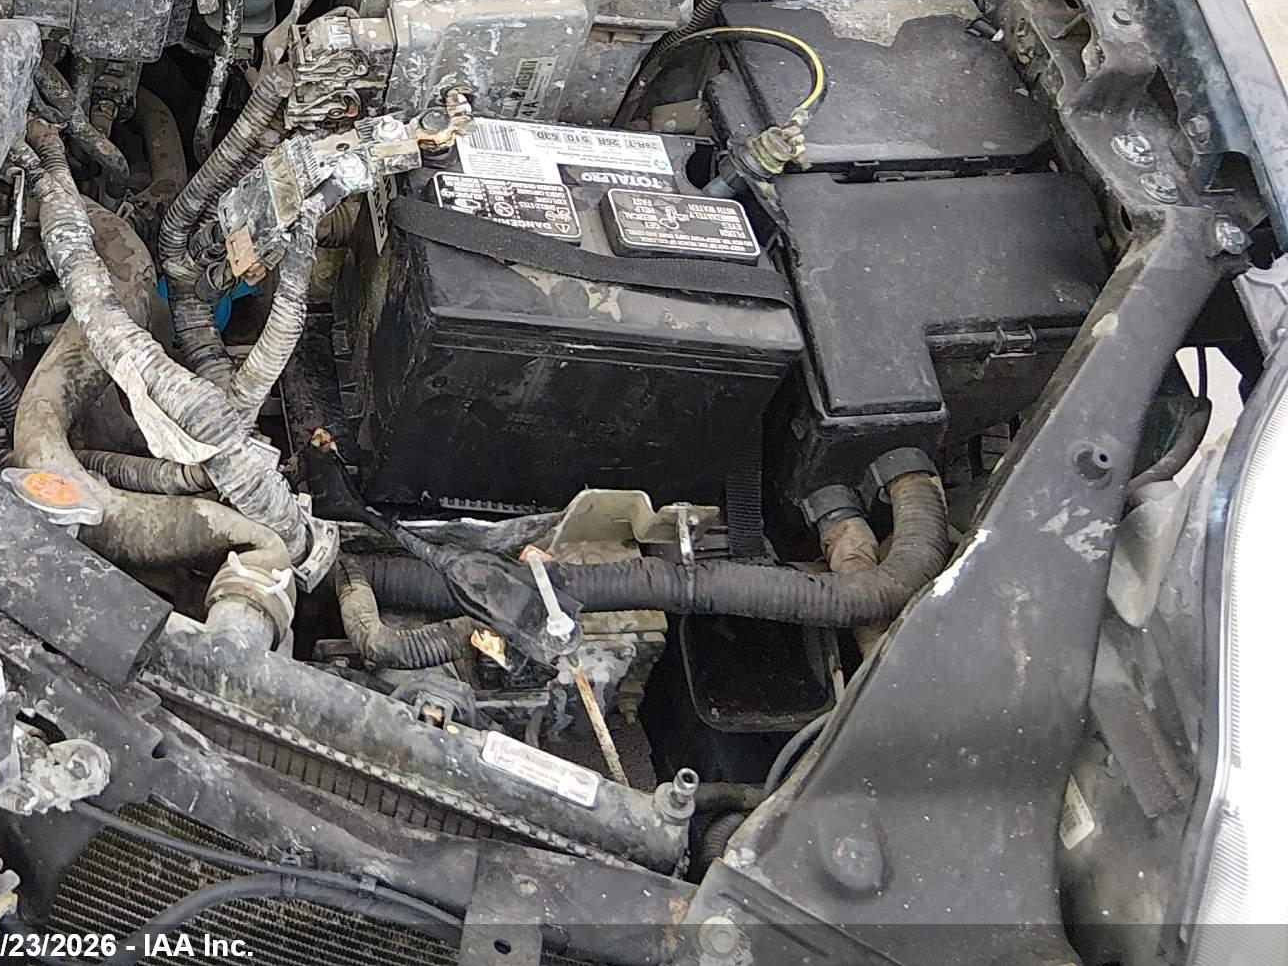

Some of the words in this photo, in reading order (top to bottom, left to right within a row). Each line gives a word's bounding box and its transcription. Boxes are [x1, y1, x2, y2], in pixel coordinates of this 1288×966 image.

[537, 131, 560, 141] 630
[567, 134, 590, 143] 510
[581, 172, 662, 188] TOTALPRO
[632, 197, 653, 206] FAST
[634, 206, 655, 214] HELP
[687, 203, 715, 214] WATER
[623, 211, 658, 221] MEDICAL
[644, 221, 660, 229] GET
